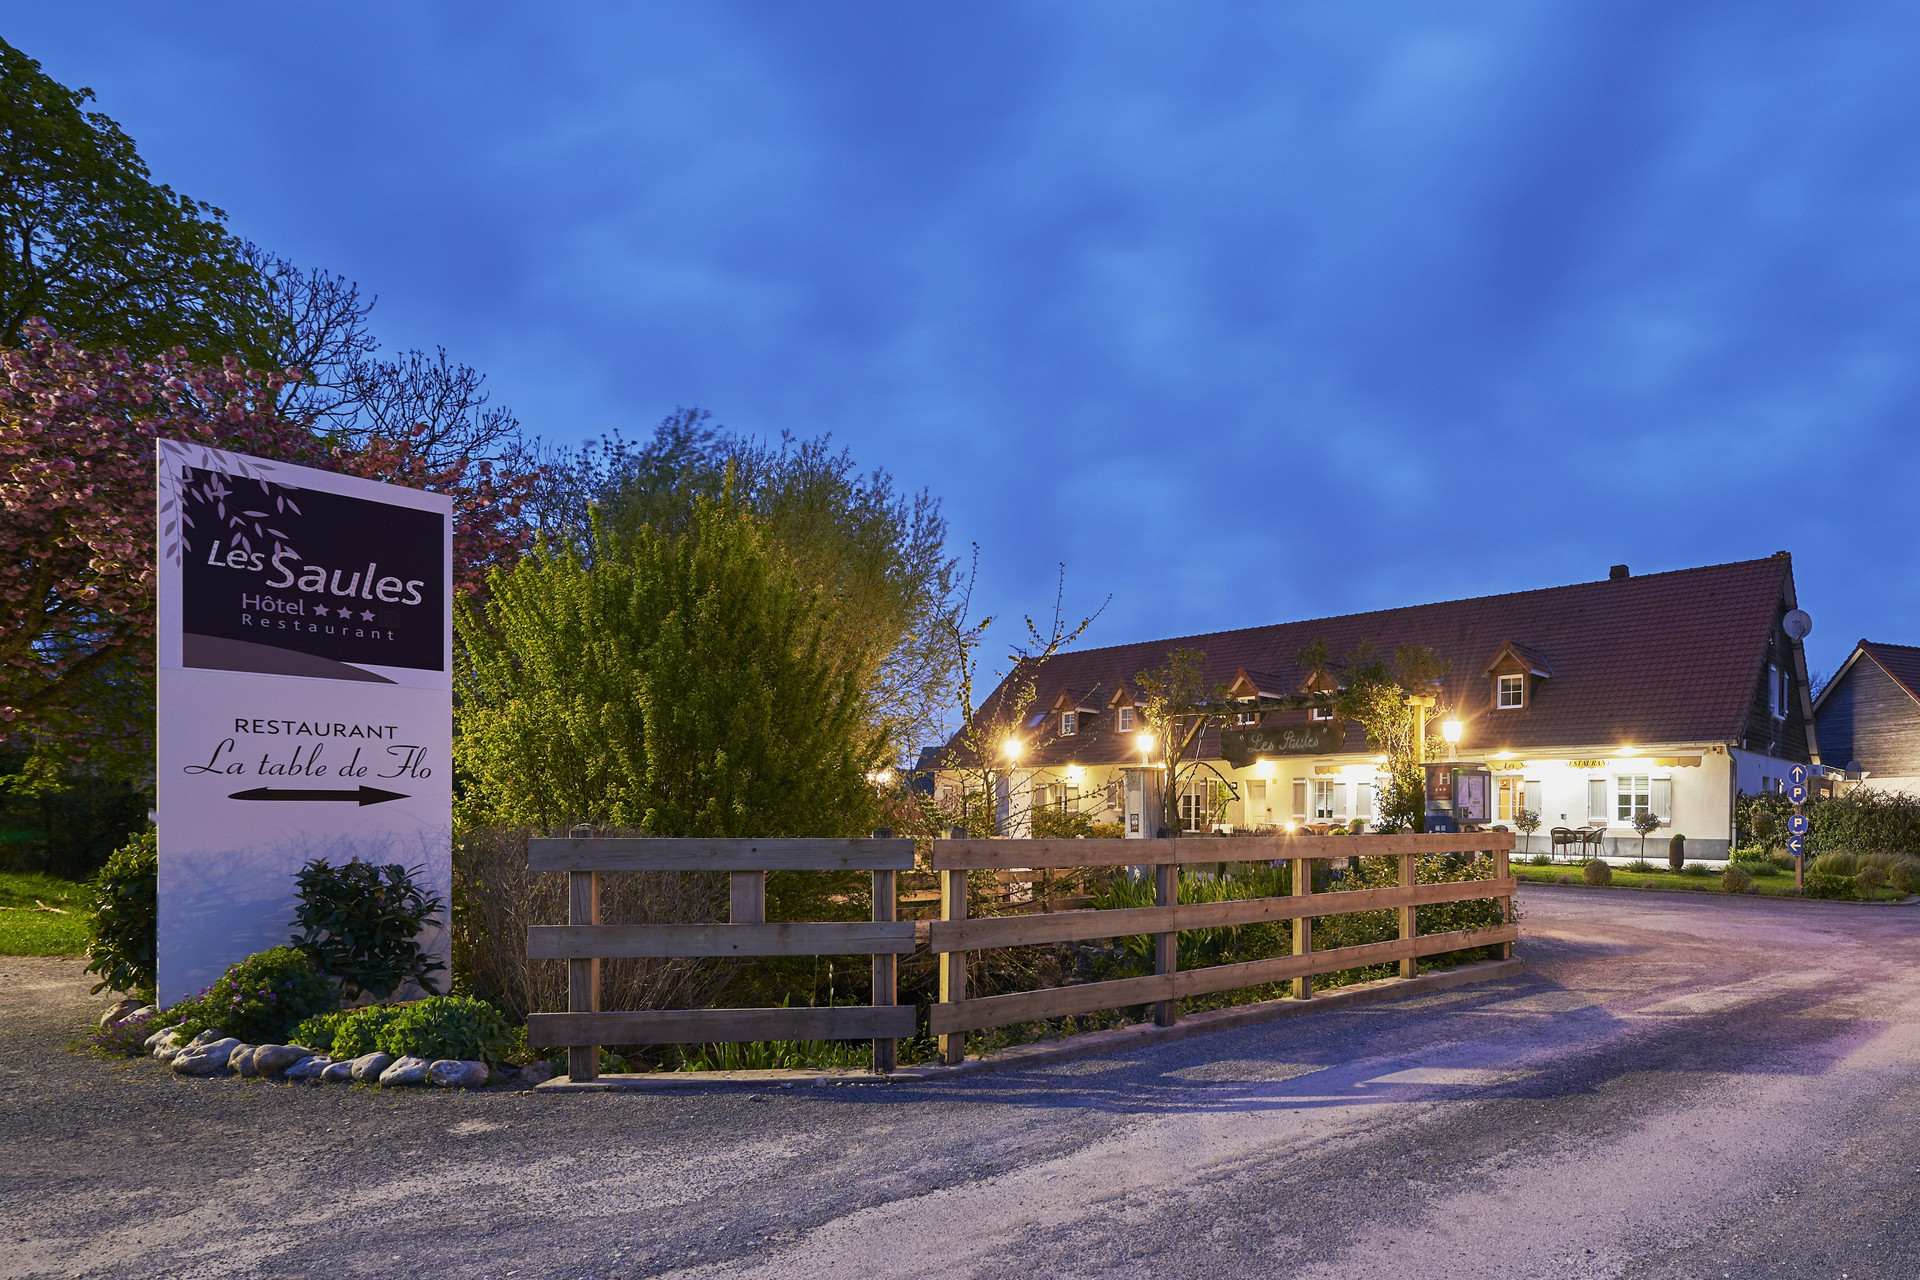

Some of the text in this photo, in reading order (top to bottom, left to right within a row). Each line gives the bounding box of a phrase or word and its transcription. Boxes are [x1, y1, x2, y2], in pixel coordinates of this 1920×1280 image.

[207, 540, 425, 606] Les Saules
[242, 593, 305, 616] Hôtel
[242, 613, 394, 641] Restaurant
[235, 718, 398, 740] RESTAURANT
[1247, 728, 1319, 752] Les Saules
[183, 738, 432, 779] La table de Flo
[1439, 772, 1450, 785] H
[1794, 788, 1801, 797] P
[1794, 818, 1802, 827] P
